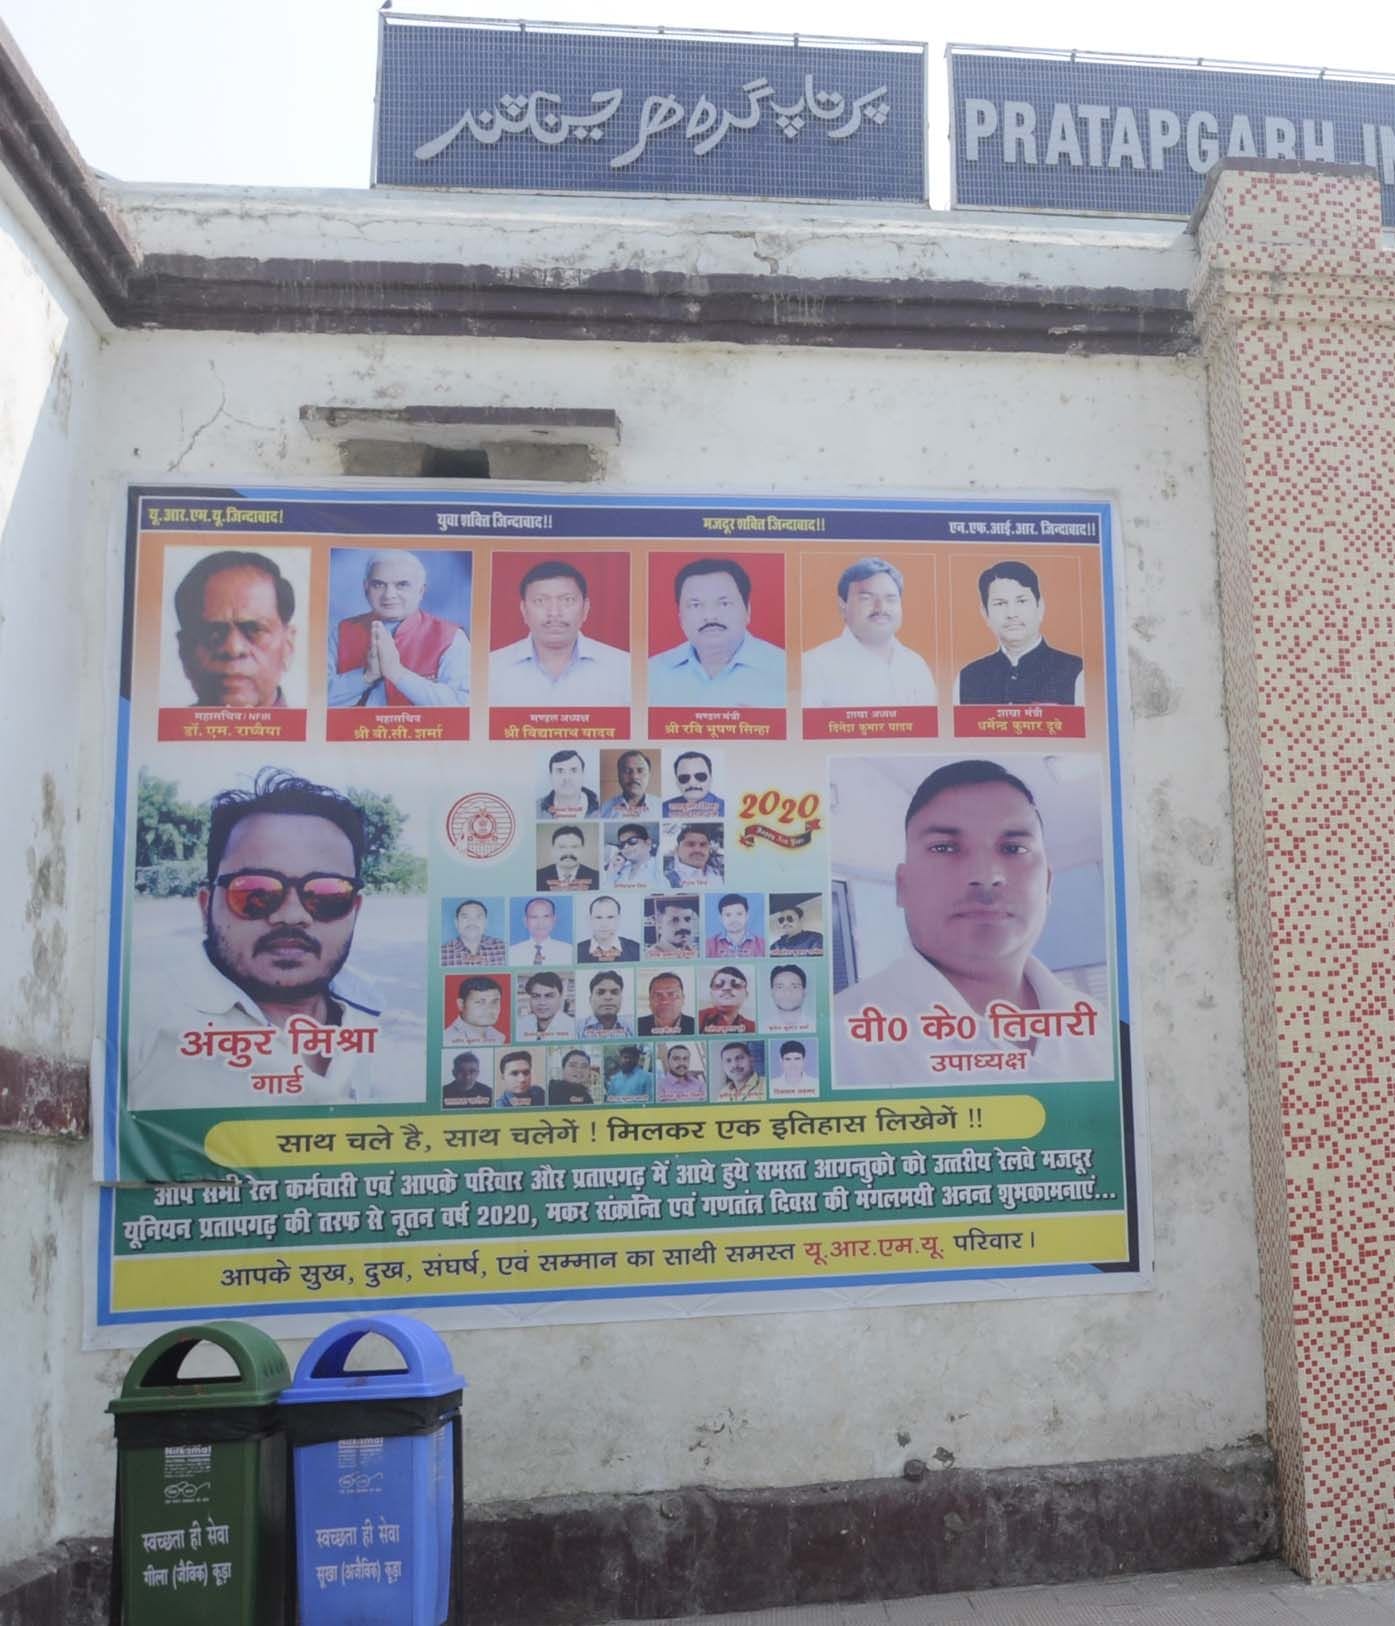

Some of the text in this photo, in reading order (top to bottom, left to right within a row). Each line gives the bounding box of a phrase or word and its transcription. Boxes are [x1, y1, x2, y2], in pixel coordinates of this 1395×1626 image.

[437, 512, 459, 531] युवा
[703, 516, 735, 535] मजदूर
[739, 790, 820, 824] 2020
[988, 1002, 1098, 1039] तिवारी
[180, 1016, 379, 1068] अंकुर मिश्रा
[251, 1065, 304, 1095] गार्ड
[930, 1051, 1028, 1073] उपाध्यक्ष
[276, 1131, 336, 1155] साथ
[346, 1123, 394, 1152] चले
[444, 1125, 502, 1149] साथ
[606, 1115, 707, 1142] मिलकर
[716, 1116, 761, 1140] एक
[771, 1111, 867, 1139] इतिहास
[247, 1145, 1093, 1202] रेल कर्मचारी एवं आपके परिवार और प्रतापगढ़ में आये हुये समस्त को उत्तरीय रेलवे मजदूर
[122, 1214, 192, 1249] यूनियन
[199, 1213, 279, 1241] प्रतापगढ़
[284, 1207, 312, 1235] की
[318, 1210, 361, 1234] तरफ
[366, 1204, 384, 1231] से
[391, 1206, 435, 1238] नूतन
[441, 1200, 470, 1227] वर्ष
[477, 1203, 538, 1230] 2020,
[546, 1200, 590, 1223] मकर
[669, 1192, 696, 1219] एवं
[770, 1188, 818, 1214] दिवस
[823, 1186, 850, 1211] की
[855, 1182, 935, 1210] मंगलमयी
[941, 1183, 992, 1207] अनन्त
[220, 1259, 292, 1287] आपके
[299, 1262, 355, 1291] सुख,
[364, 1258, 413, 1288] दुख,
[496, 1249, 529, 1276] एवं
[537, 1250, 618, 1273] सम्मान
[626, 1249, 654, 1268] का
[664, 1240, 717, 1267] साथी
[724, 1242, 797, 1265] समस्त
[953, 1226, 1024, 1252] परिवार
[189, 1519, 203, 1551] ही
[206, 1514, 230, 1545] सेवा
[361, 1518, 374, 1549] ही
